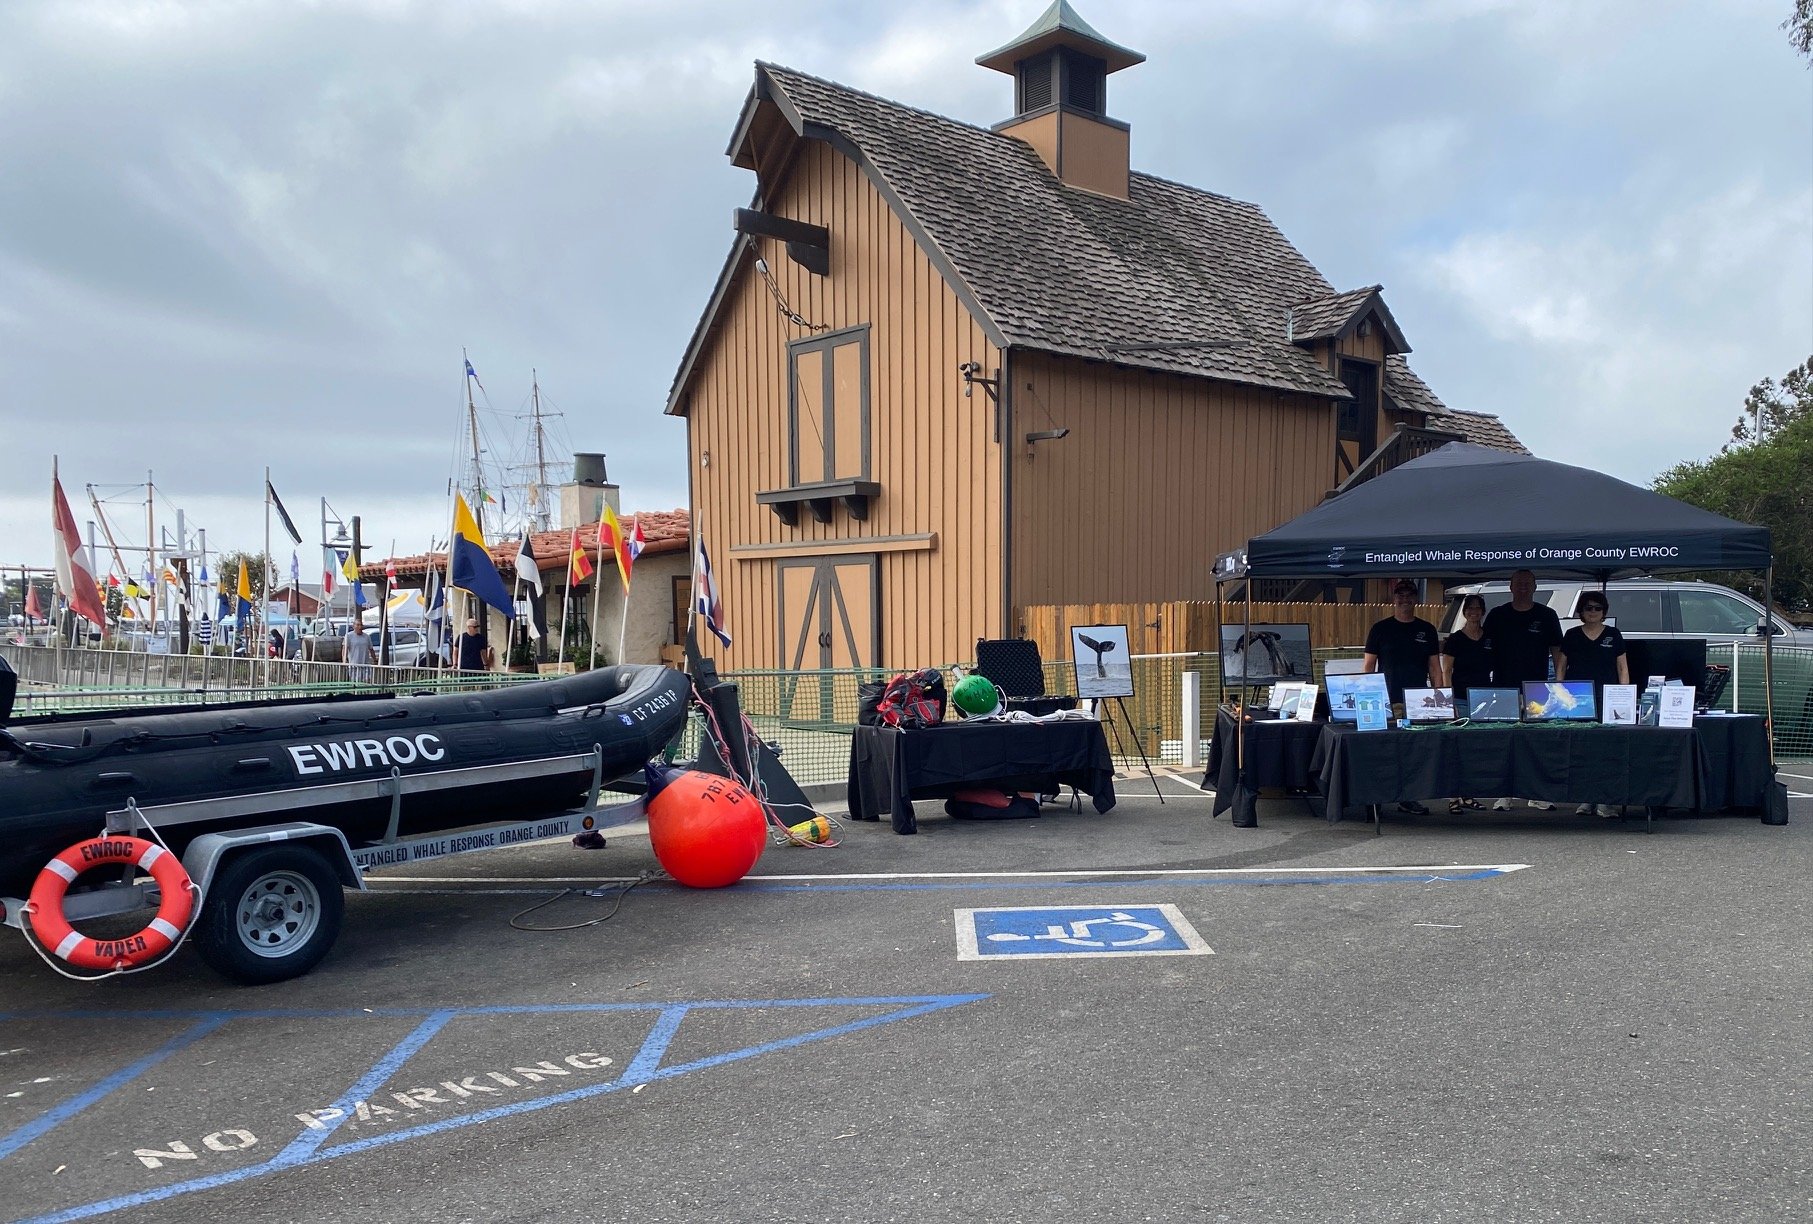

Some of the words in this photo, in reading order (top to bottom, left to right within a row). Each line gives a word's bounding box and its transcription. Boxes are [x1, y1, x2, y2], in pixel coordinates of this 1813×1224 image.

[1365, 550, 1422, 564] Entangled
[1425, 549, 1462, 561] Whale
[1464, 549, 1522, 562] Response
[1525, 547, 1537, 559] of
[1539, 547, 1582, 560] Orange
[1585, 546, 1627, 560] County
[1629, 546, 1679, 557] EWROC
[632, 706, 648, 721] CF
[644, 695, 670, 714] 2436
[287, 733, 445, 775] EWROC
[80, 841, 133, 862] EWROC
[354, 847, 408, 868] NTANGLED
[412, 841, 446, 859] WHALE
[450, 833, 495, 853] RESPONSE
[500, 826, 534, 844] ORANGE
[537, 820, 569, 838] COUNTY
[95, 935, 147, 957] VADER
[132, 1128, 259, 1169] NO
[295, 1052, 614, 1131] PARKING
